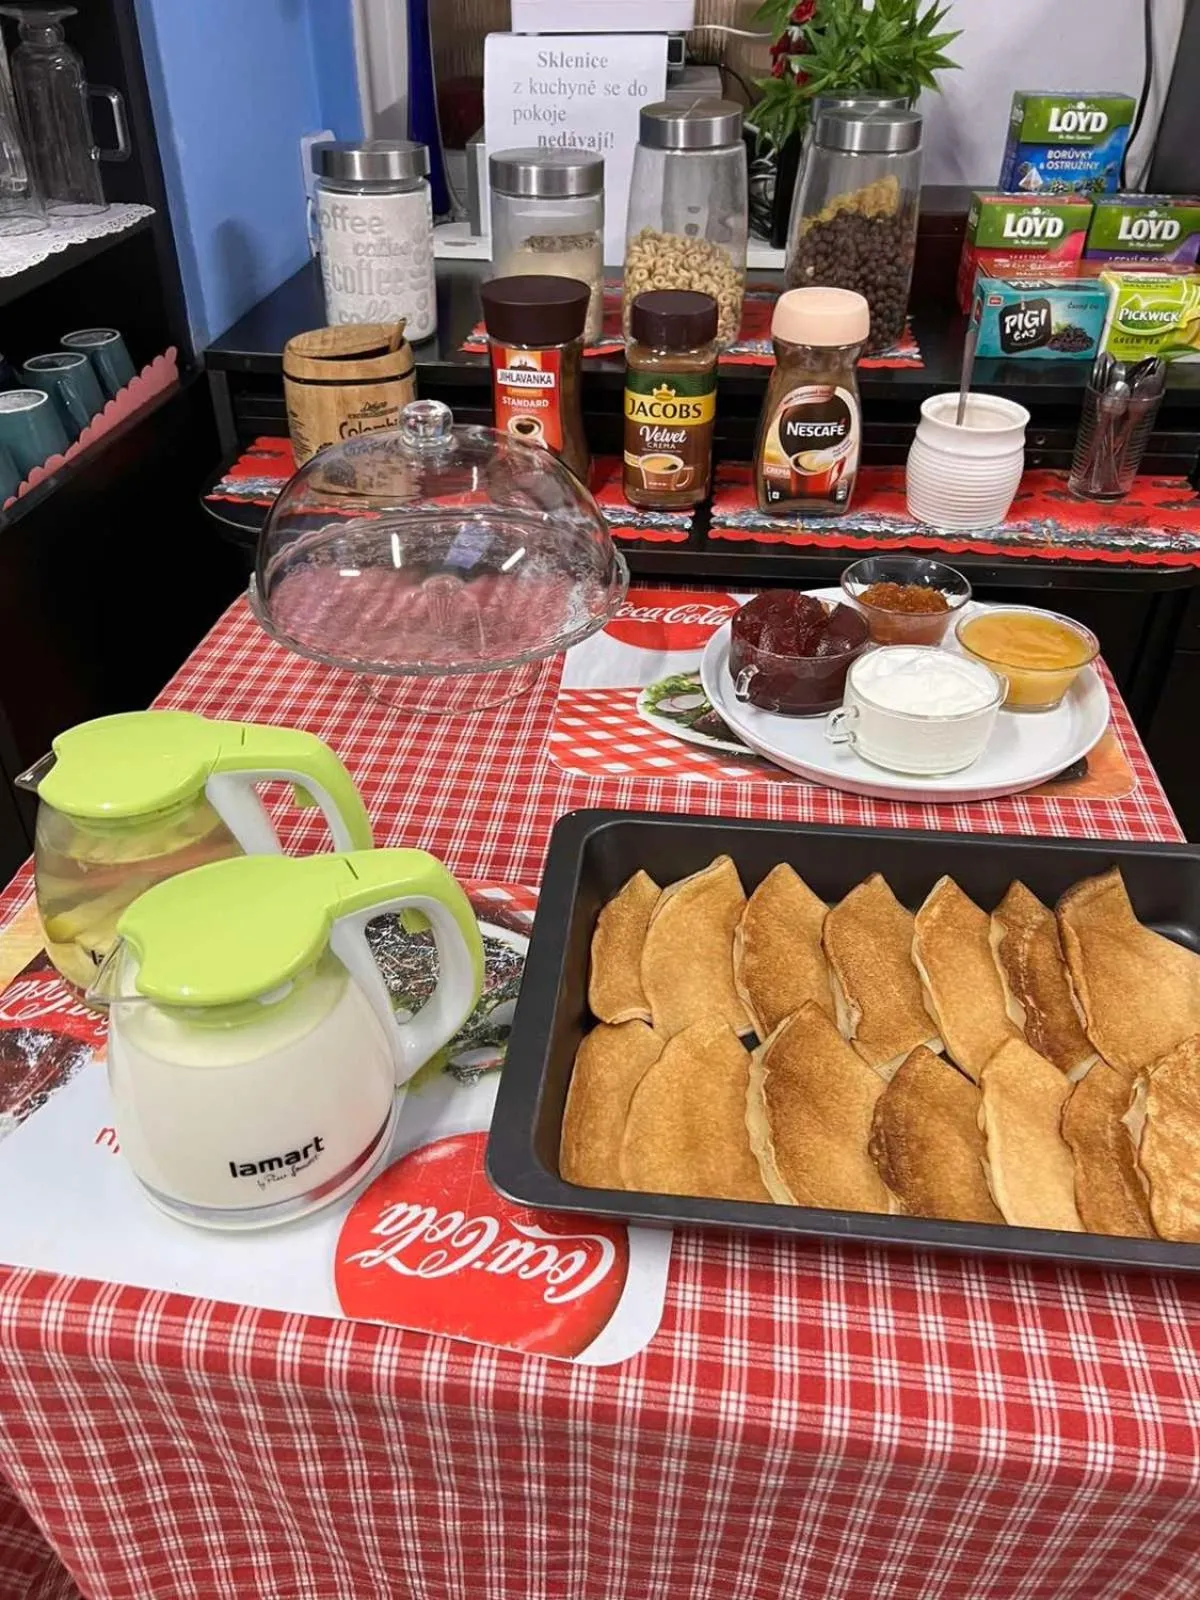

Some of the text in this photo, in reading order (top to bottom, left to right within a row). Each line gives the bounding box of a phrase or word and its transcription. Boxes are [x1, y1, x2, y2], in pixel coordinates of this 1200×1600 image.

[536, 50, 609, 69] Sklenice
[512, 77, 648, 99] z kuchyně se do
[512, 102, 567, 125] pokoje
[1048, 106, 1109, 133] LOYD
[536, 130, 615, 150] nedávají!
[1046, 147, 1094, 160] BORŮVKY
[1046, 160, 1100, 171] OSTRUŽINY
[1003, 212, 1064, 239] LOYD
[1117, 216, 1181, 241] LOYD
[331, 259, 406, 297] coffee
[1005, 309, 1048, 335] PIGI
[1118, 308, 1180, 322] PICKWICK
[499, 371, 553, 385] JIHLAVANKA
[502, 396, 550, 409] STANDARD
[628, 398, 703, 419] JACOBS
[639, 425, 688, 443] Velvet
[786, 419, 846, 437] NESCAFÉ
[228, 1136, 325, 1179] lamart
